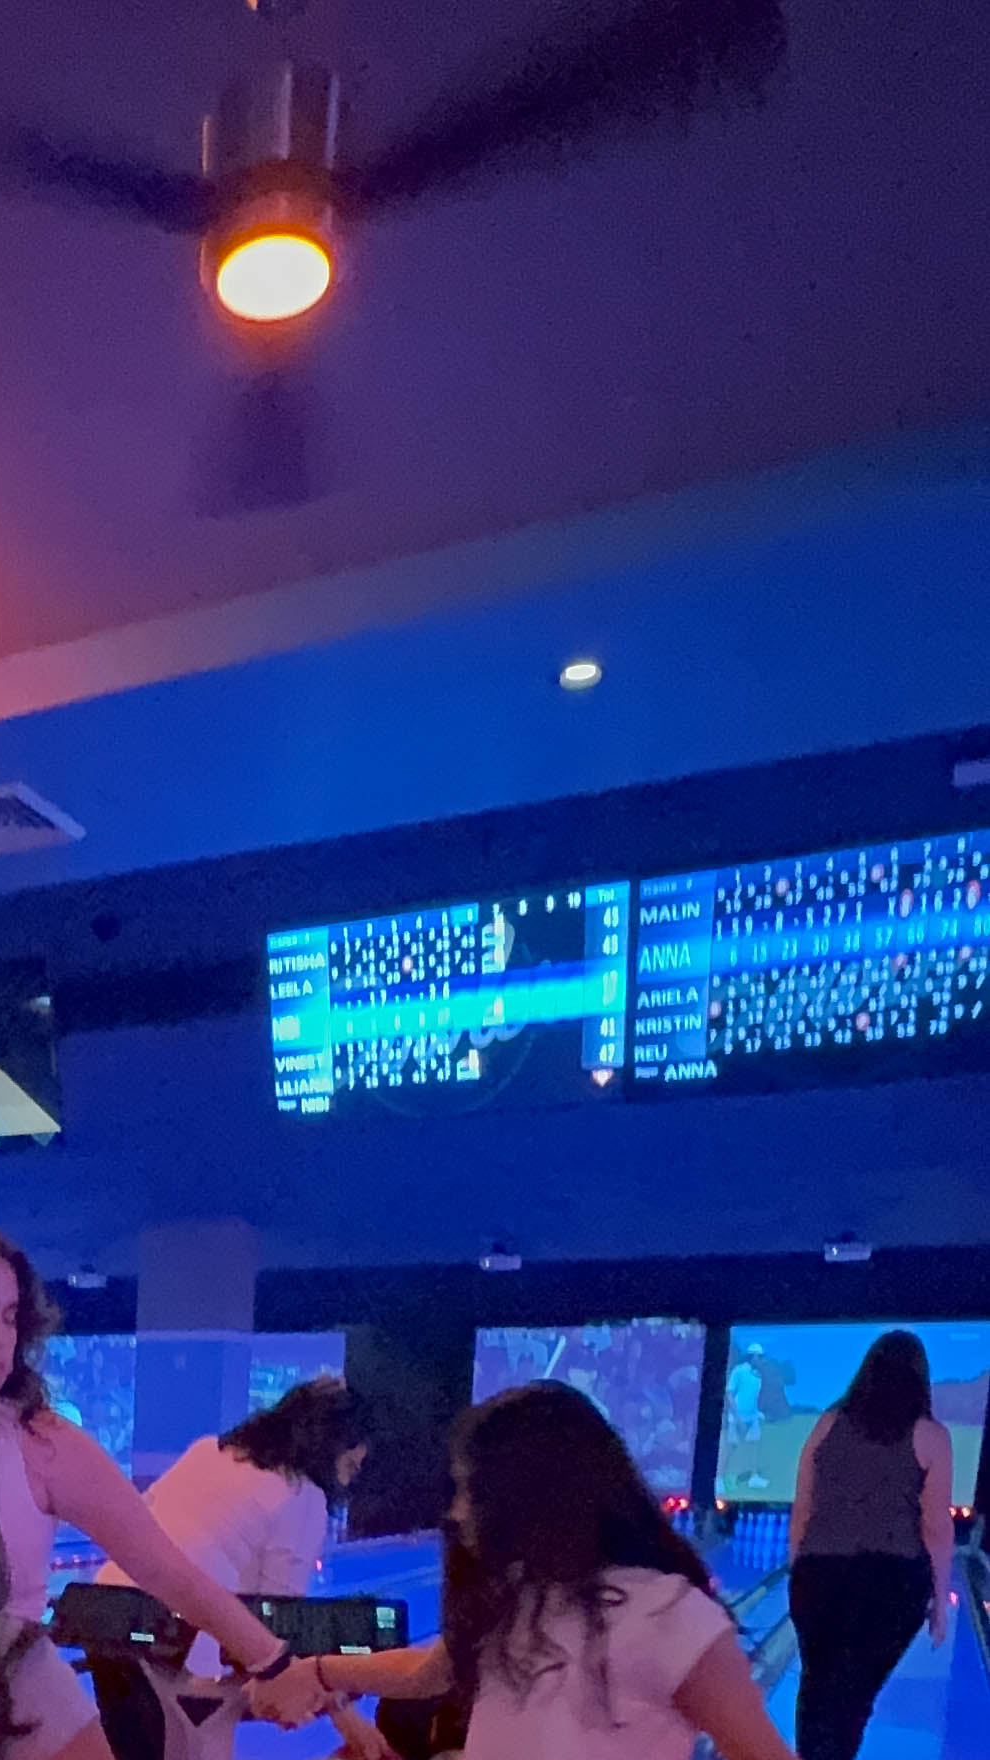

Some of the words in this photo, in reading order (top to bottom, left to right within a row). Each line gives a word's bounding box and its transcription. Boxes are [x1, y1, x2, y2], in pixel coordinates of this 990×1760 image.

[640, 901, 700, 925] MALIN
[639, 941, 691, 974] ANNA
[637, 986, 698, 1010] ARIELA
[635, 1014, 702, 1036] KRISTIN
[664, 1060, 718, 1082] ANNA
